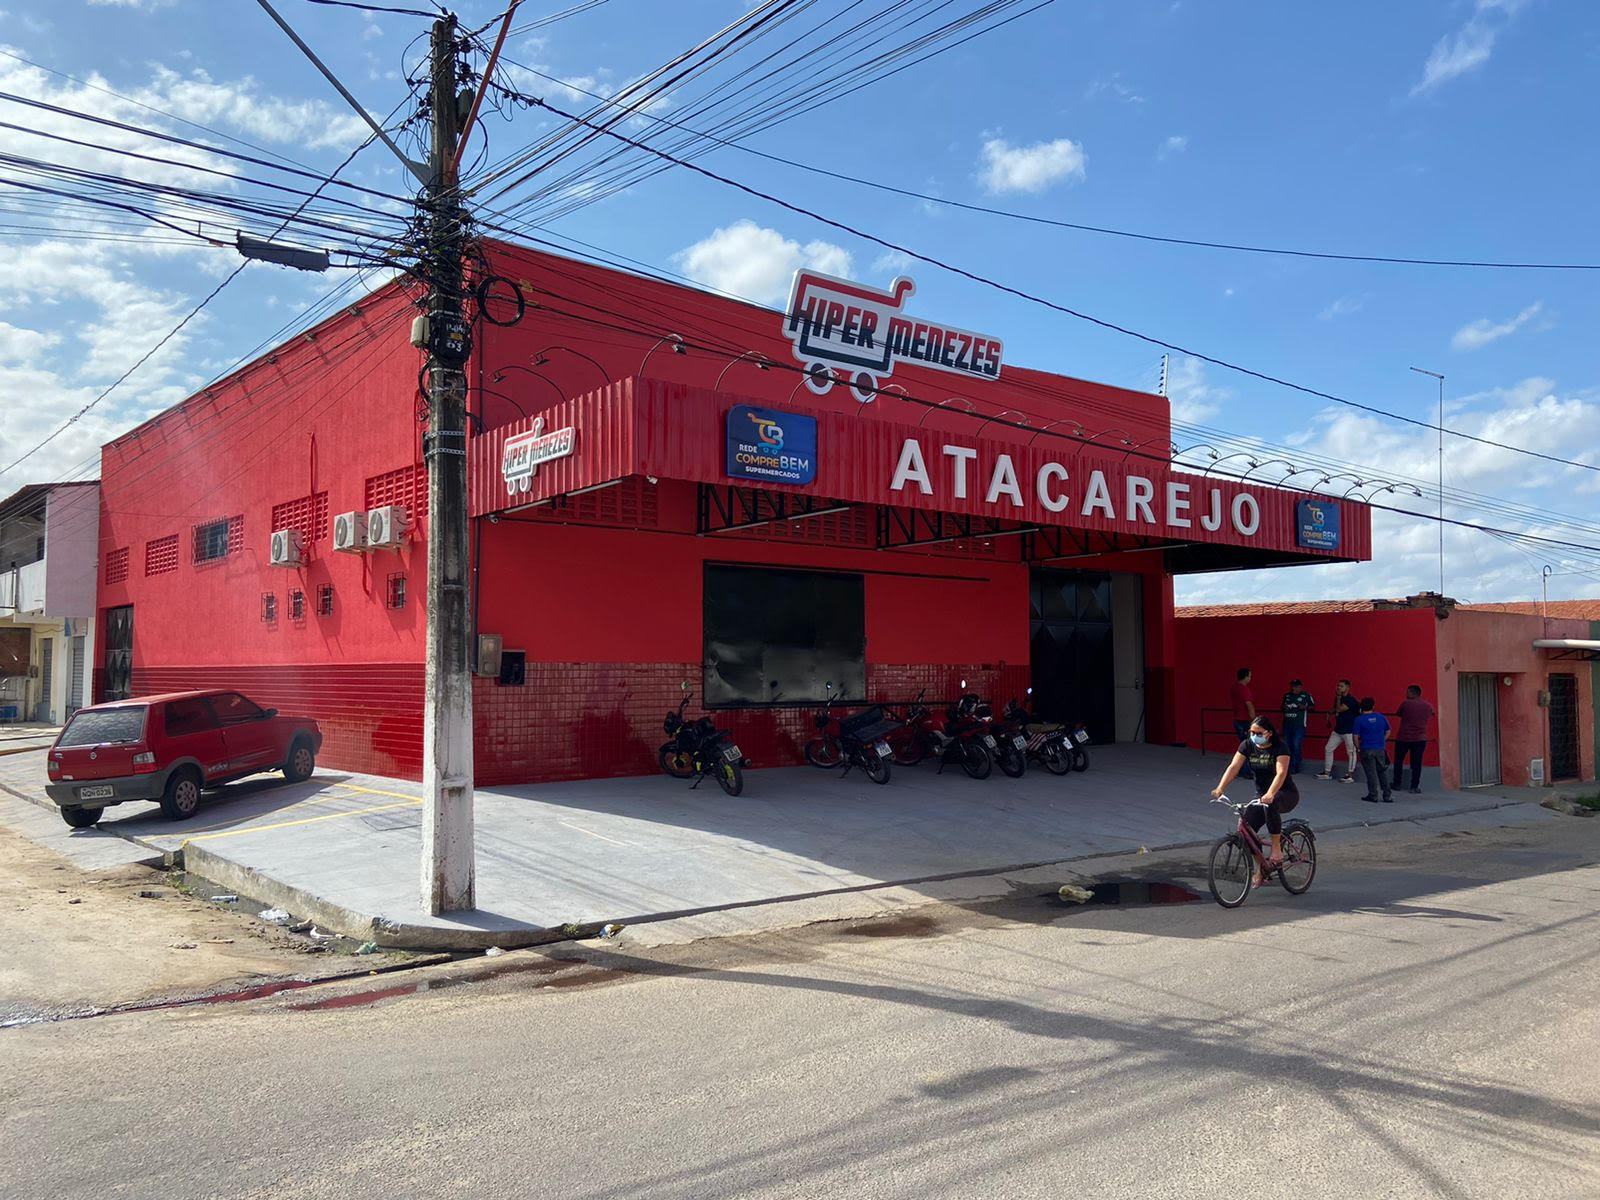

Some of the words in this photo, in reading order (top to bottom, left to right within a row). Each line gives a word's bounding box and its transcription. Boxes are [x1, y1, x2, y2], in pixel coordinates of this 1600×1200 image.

[789, 296, 878, 349] HIPER
[887, 317, 1000, 376] MENEZES
[739, 444, 757, 453] REDE
[745, 466, 800, 479] SUPERMERCADOS
[890, 438, 1260, 536] ATACAREJO
